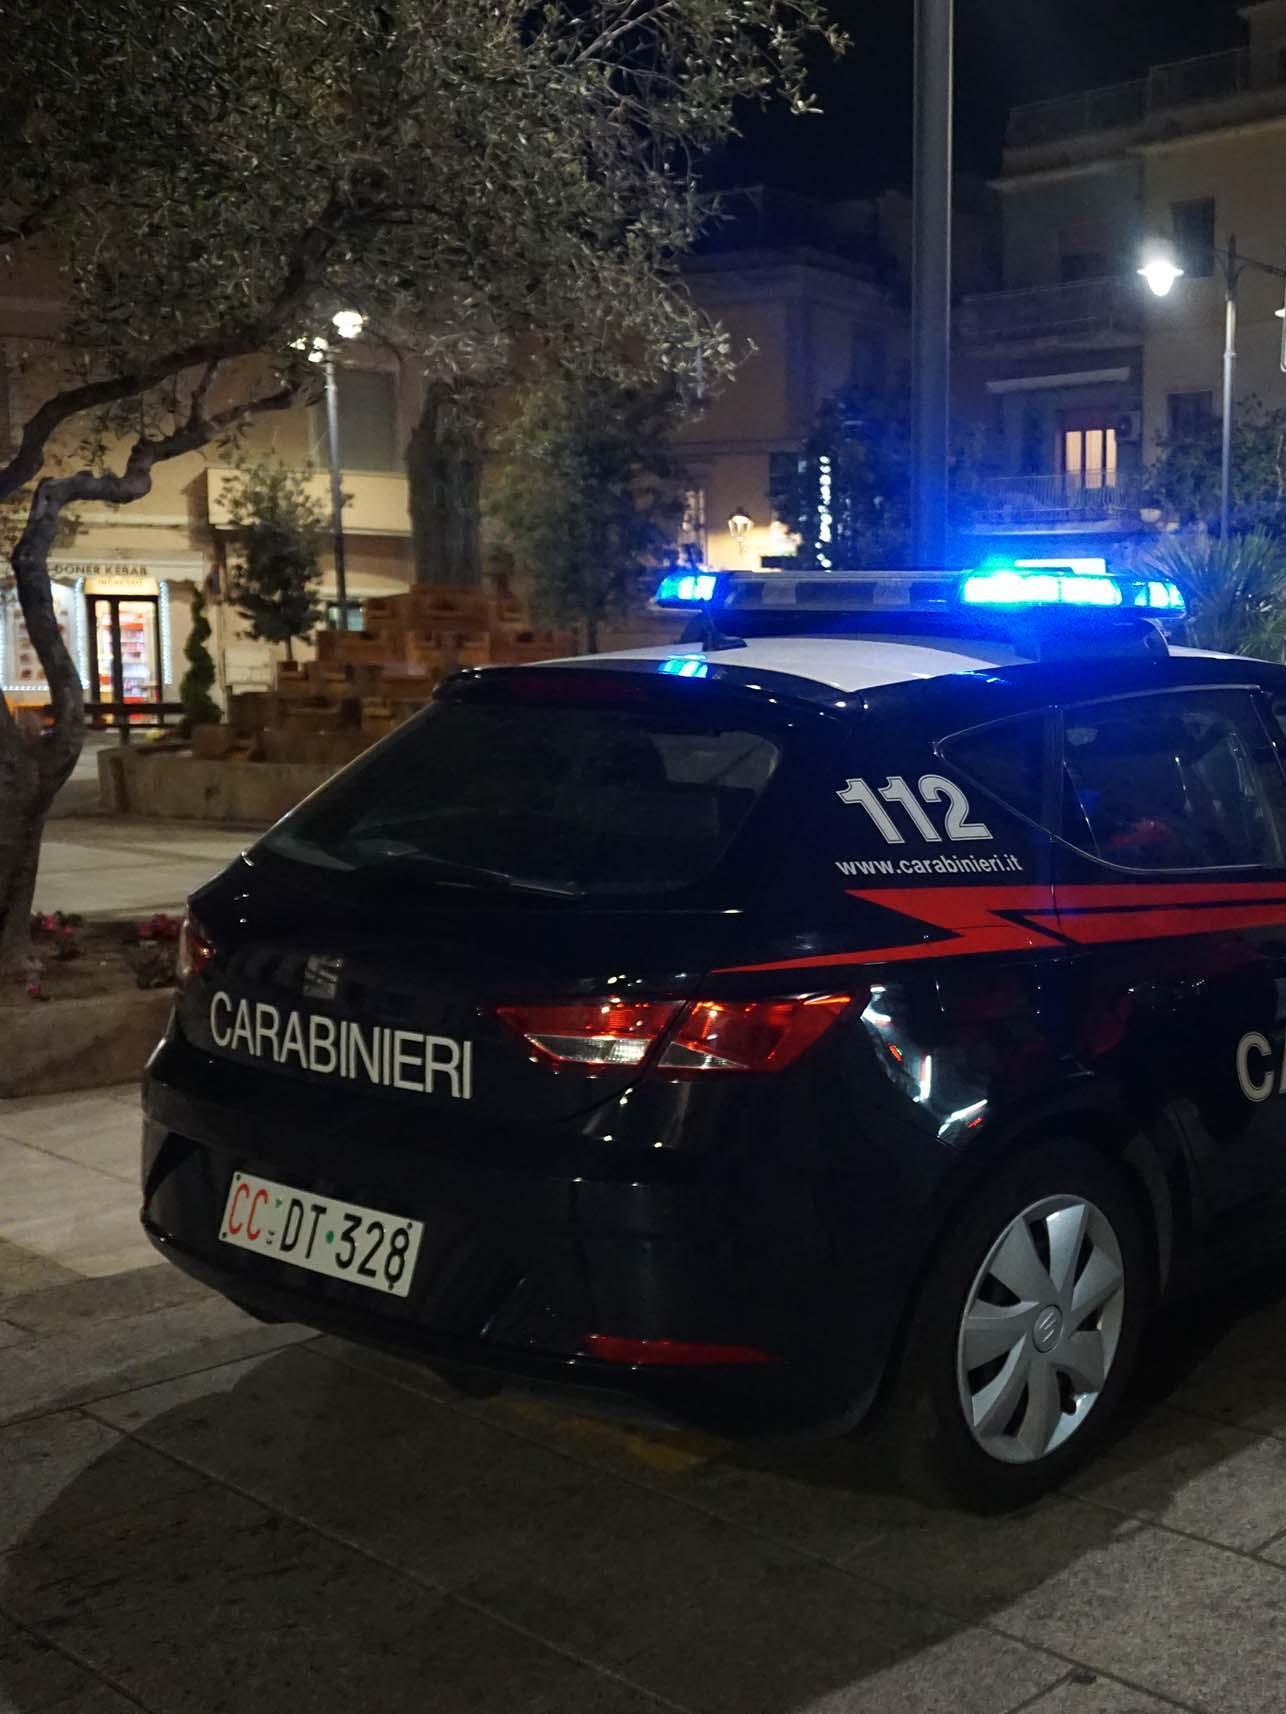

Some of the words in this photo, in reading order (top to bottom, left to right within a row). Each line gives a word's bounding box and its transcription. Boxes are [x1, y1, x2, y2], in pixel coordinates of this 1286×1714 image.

[104, 565, 148, 576] KEBAB
[835, 773, 994, 844] 112
[835, 854, 1024, 876] www.carabinieri.it
[210, 991, 473, 1100] CARABINIERI
[228, 1183, 269, 1241] CC
[280, 1198, 327, 1259] DT
[335, 1213, 410, 1285] 328
